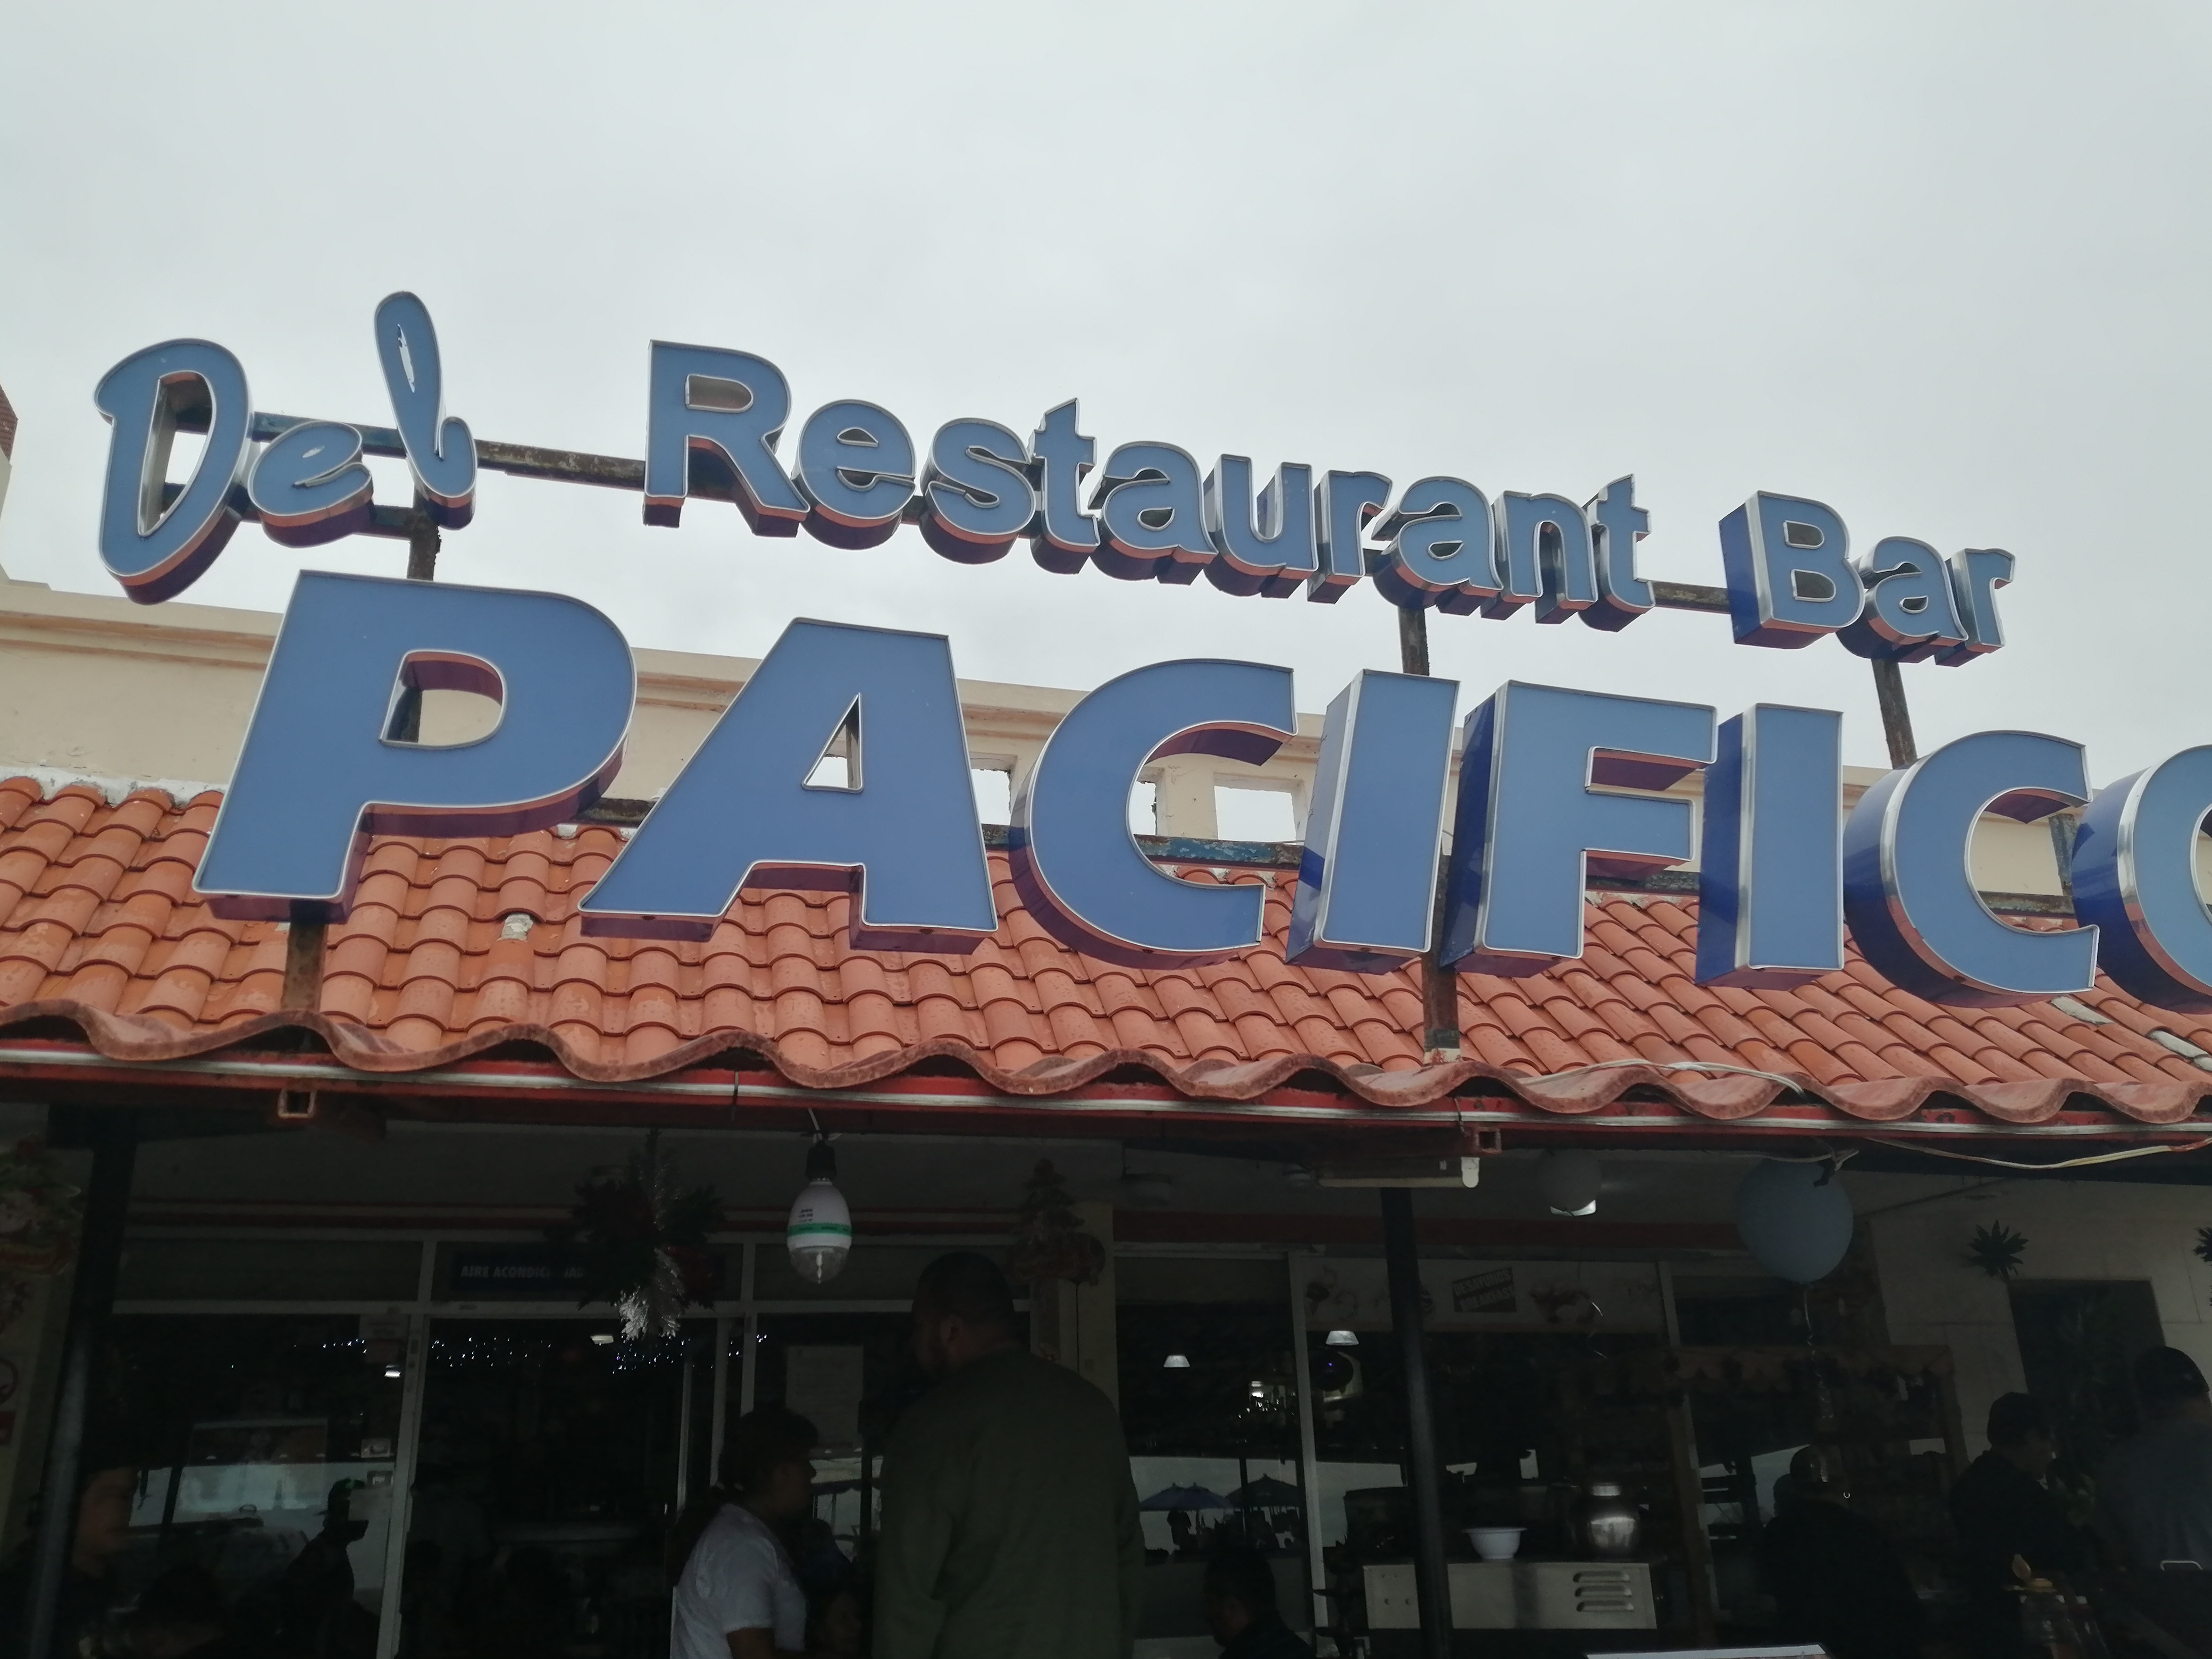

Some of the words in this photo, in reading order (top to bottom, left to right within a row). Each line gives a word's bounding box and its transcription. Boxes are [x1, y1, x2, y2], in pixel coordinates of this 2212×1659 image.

[93, 291, 477, 585] Del
[644, 339, 1656, 614] Restaurant
[1741, 490, 2015, 653] Bar
[460, 1265, 490, 1278] AIRE
[1452, 1269, 1512, 1296] DESAYUNOS
